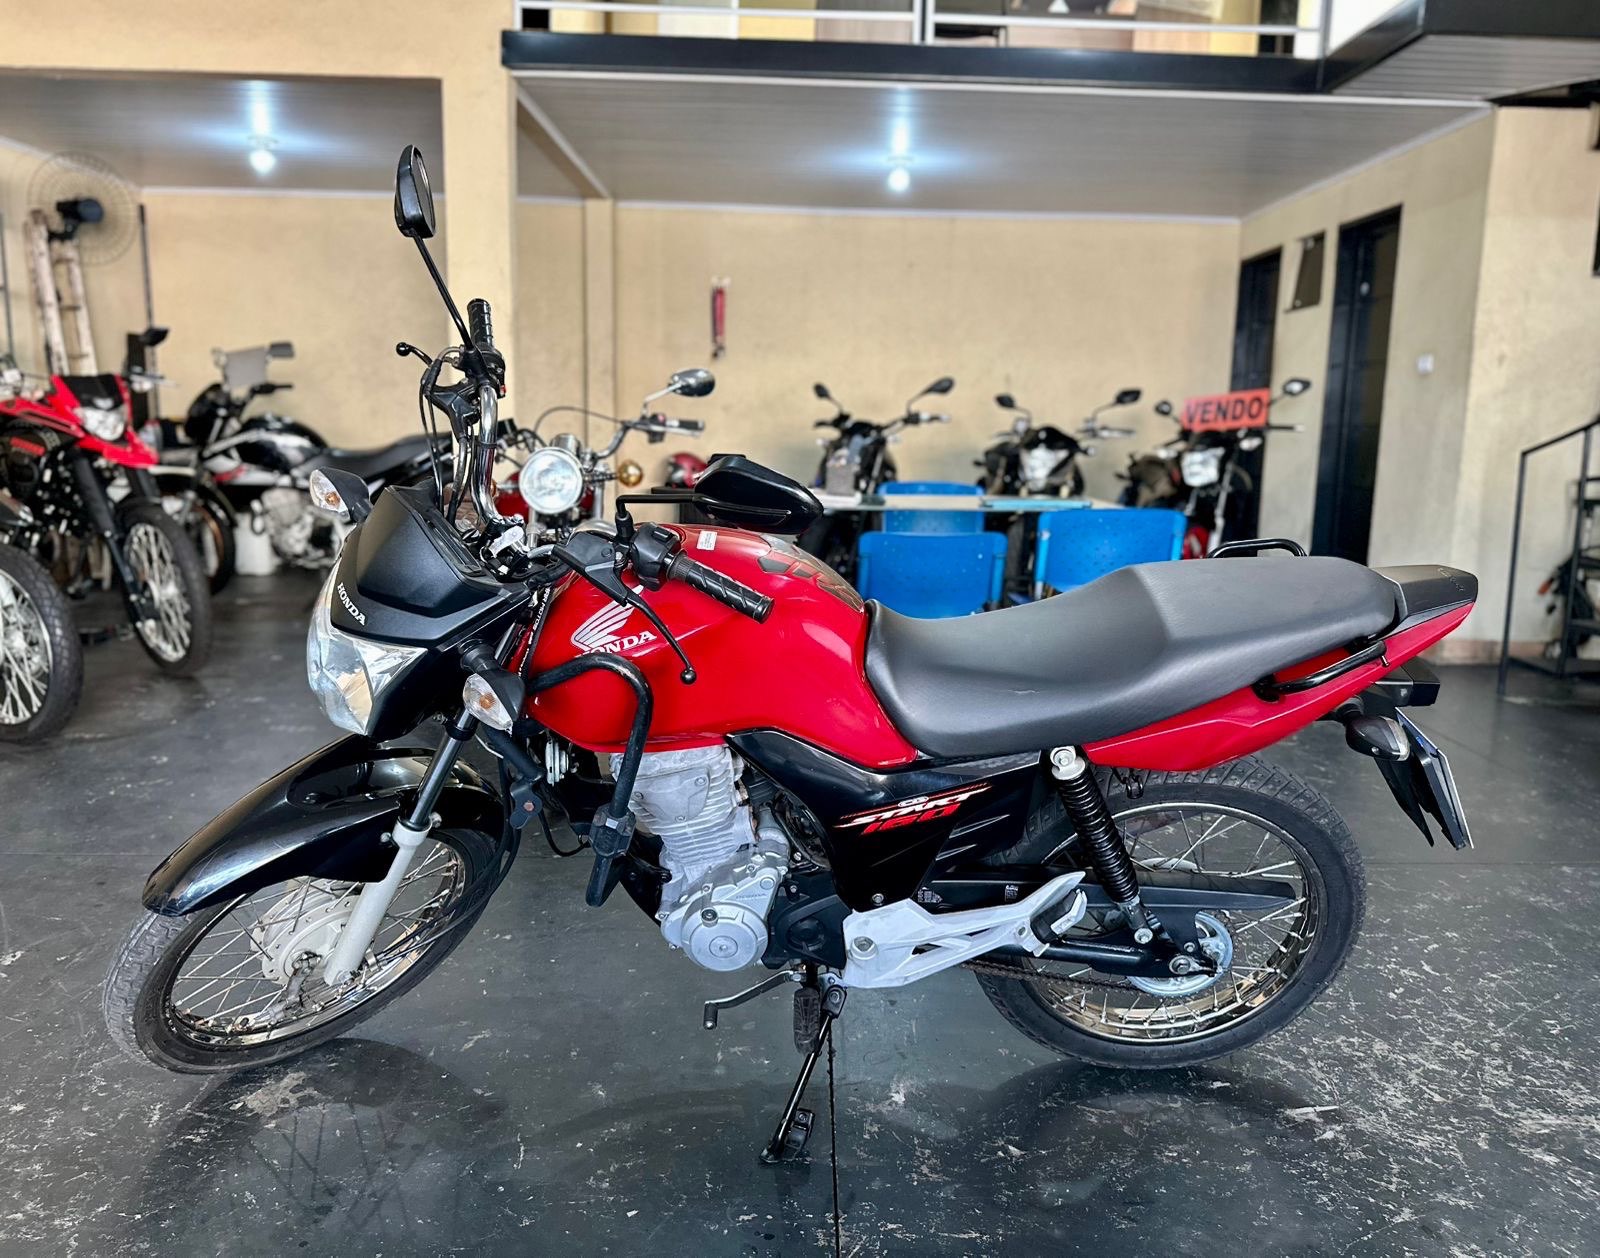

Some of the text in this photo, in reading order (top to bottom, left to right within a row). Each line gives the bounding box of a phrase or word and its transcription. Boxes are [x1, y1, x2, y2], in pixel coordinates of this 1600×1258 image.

[1186, 397, 1263, 424] VENDO
[337, 582, 366, 626] HONDA
[576, 630, 657, 657] ONDA
[861, 803, 960, 836] 160
